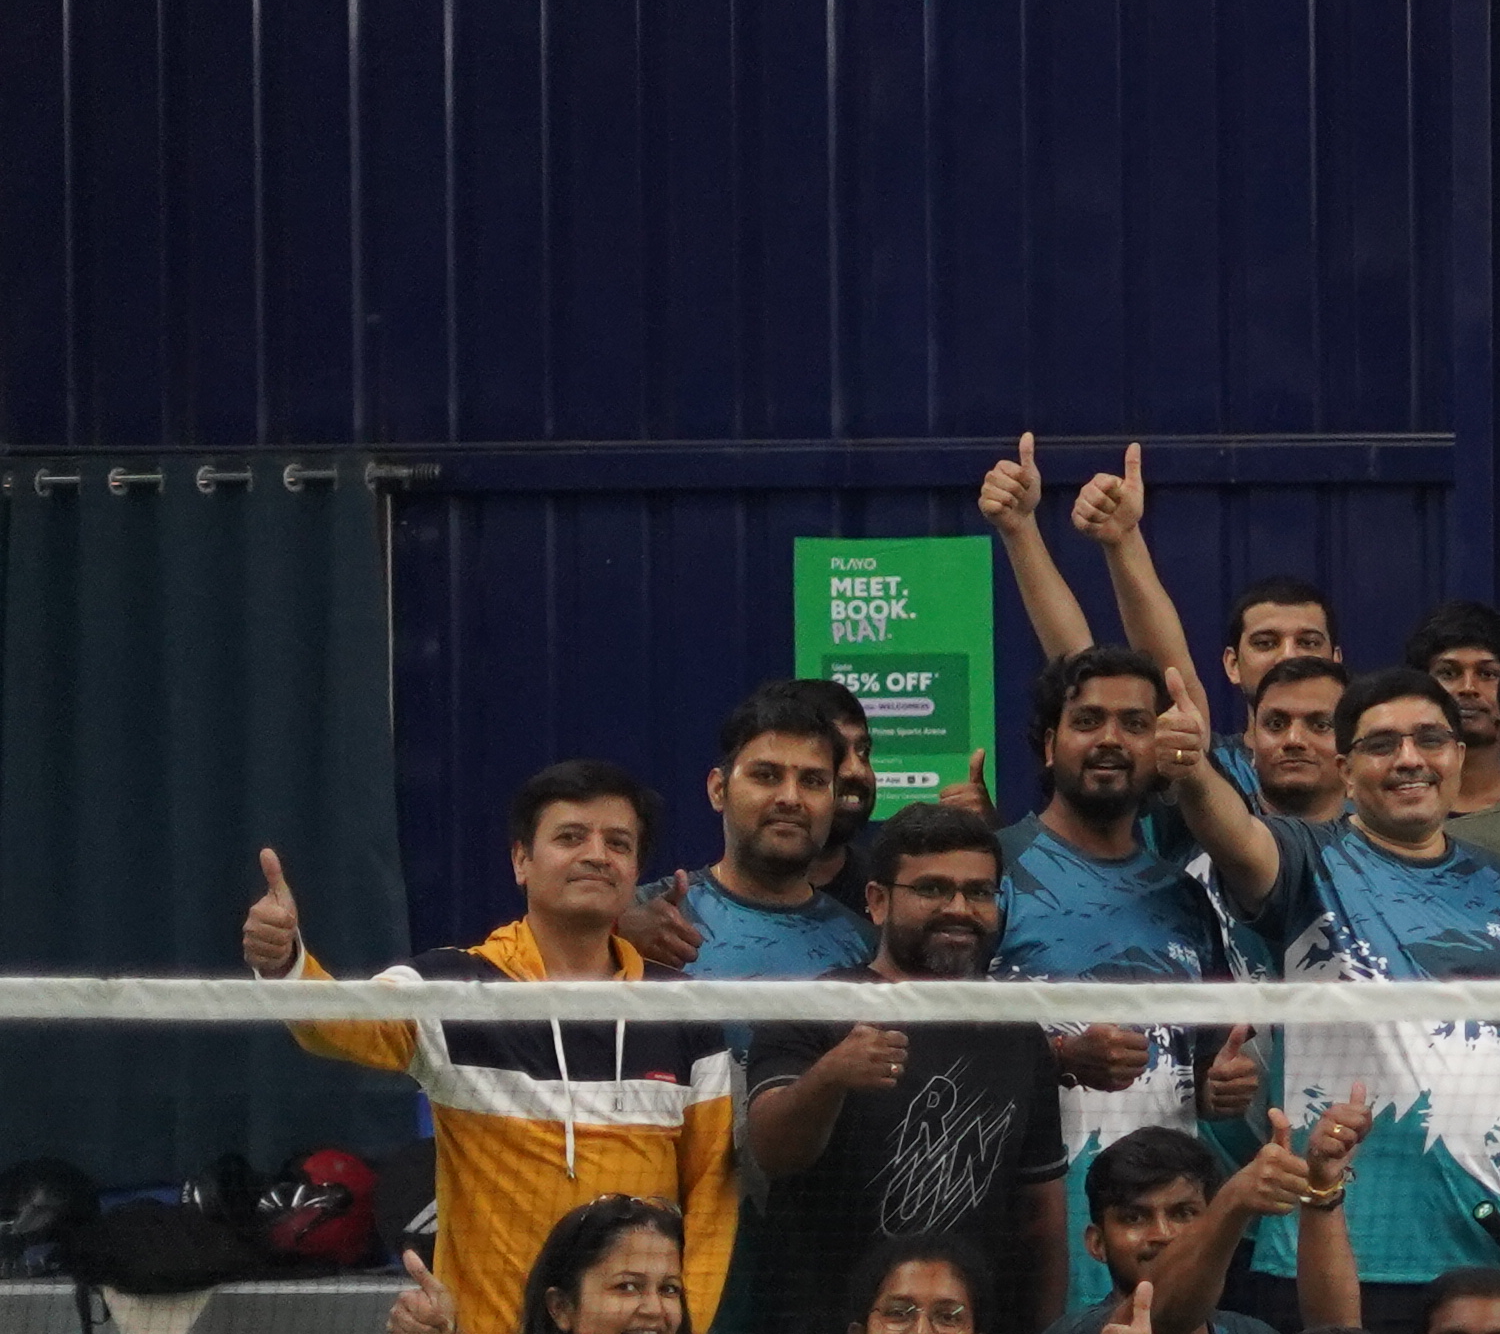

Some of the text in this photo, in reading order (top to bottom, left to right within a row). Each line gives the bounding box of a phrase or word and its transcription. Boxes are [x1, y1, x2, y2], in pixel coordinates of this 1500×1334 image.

[831, 558, 877, 571] PLAYO
[830, 576, 909, 597] MEET.
[830, 598, 916, 620] BOOK.
[832, 617, 892, 644] PLAY.
